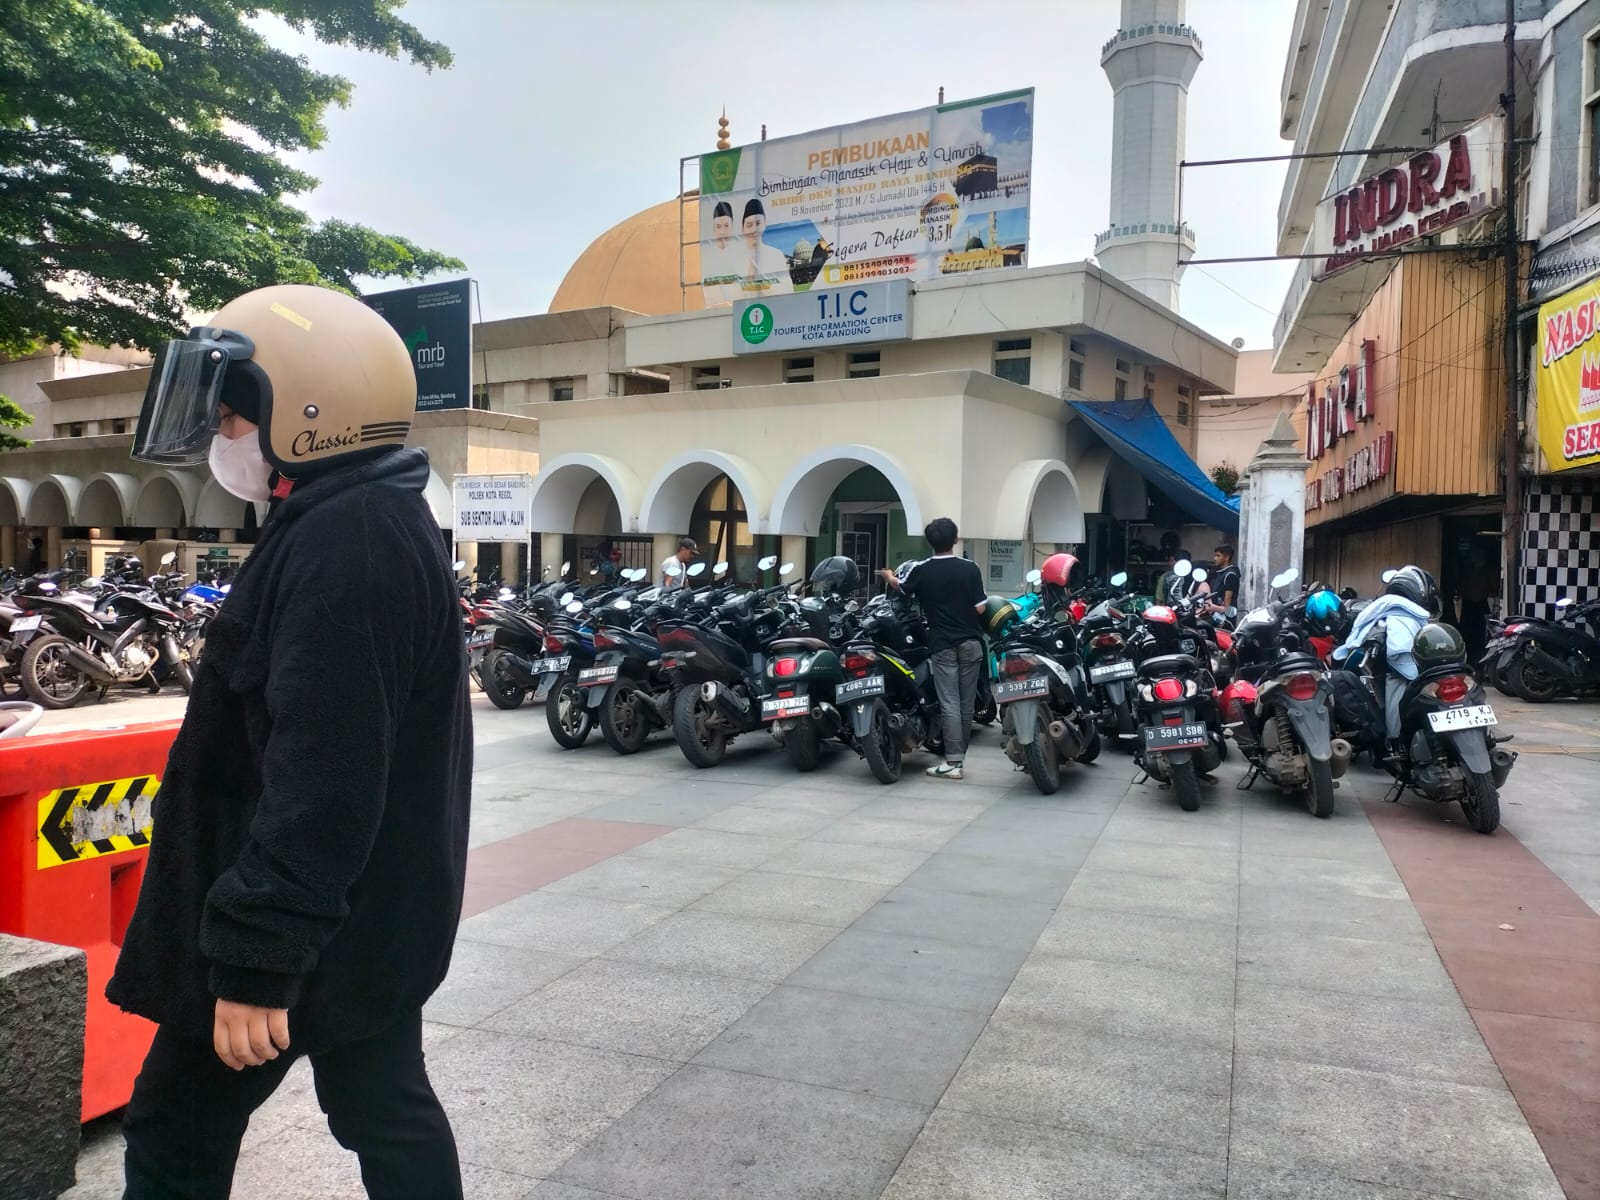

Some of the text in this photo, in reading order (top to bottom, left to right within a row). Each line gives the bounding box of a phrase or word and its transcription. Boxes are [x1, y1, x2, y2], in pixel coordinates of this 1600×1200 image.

[808, 131, 929, 170] PEMBUKAAN
[757, 176, 818, 197] Bimbingan
[820, 162, 877, 184] Manasik
[880, 156, 913, 174] Haji
[918, 151, 929, 167] &
[808, 189, 832, 200] DKM
[837, 183, 876, 194] MASJID
[881, 176, 910, 189] RAYA
[915, 165, 972, 181] BANDUNG
[791, 207, 798, 216] 19
[800, 202, 833, 215] November
[835, 196, 853, 209] 2023
[921, 183, 937, 196] 1445
[939, 181, 945, 192] H
[1333, 135, 1471, 247] INDRA
[920, 203, 959, 216] BIMBINGAN
[920, 214, 951, 225] MANASIK
[825, 228, 919, 260] Segera Daftar
[929, 225, 943, 243] 3,5
[818, 290, 868, 319] T.I.C
[774, 326, 805, 337] TOURIST
[808, 319, 869, 332] INFORMATION
[870, 313, 903, 325] CENTER
[802, 326, 871, 341] KOTA BANDUNG
[1543, 299, 1597, 368] NASI
[418, 341, 445, 362] mrb
[292, 427, 360, 457] Classic
[469, 490, 512, 500] POLSEK KOTA REGOL
[461, 511, 471, 526] SUB
[472, 511, 491, 526] SEKTOR
[1430, 714, 1438, 723] D
[1446, 708, 1470, 720] 4719
[1148, 730, 1154, 740] D
